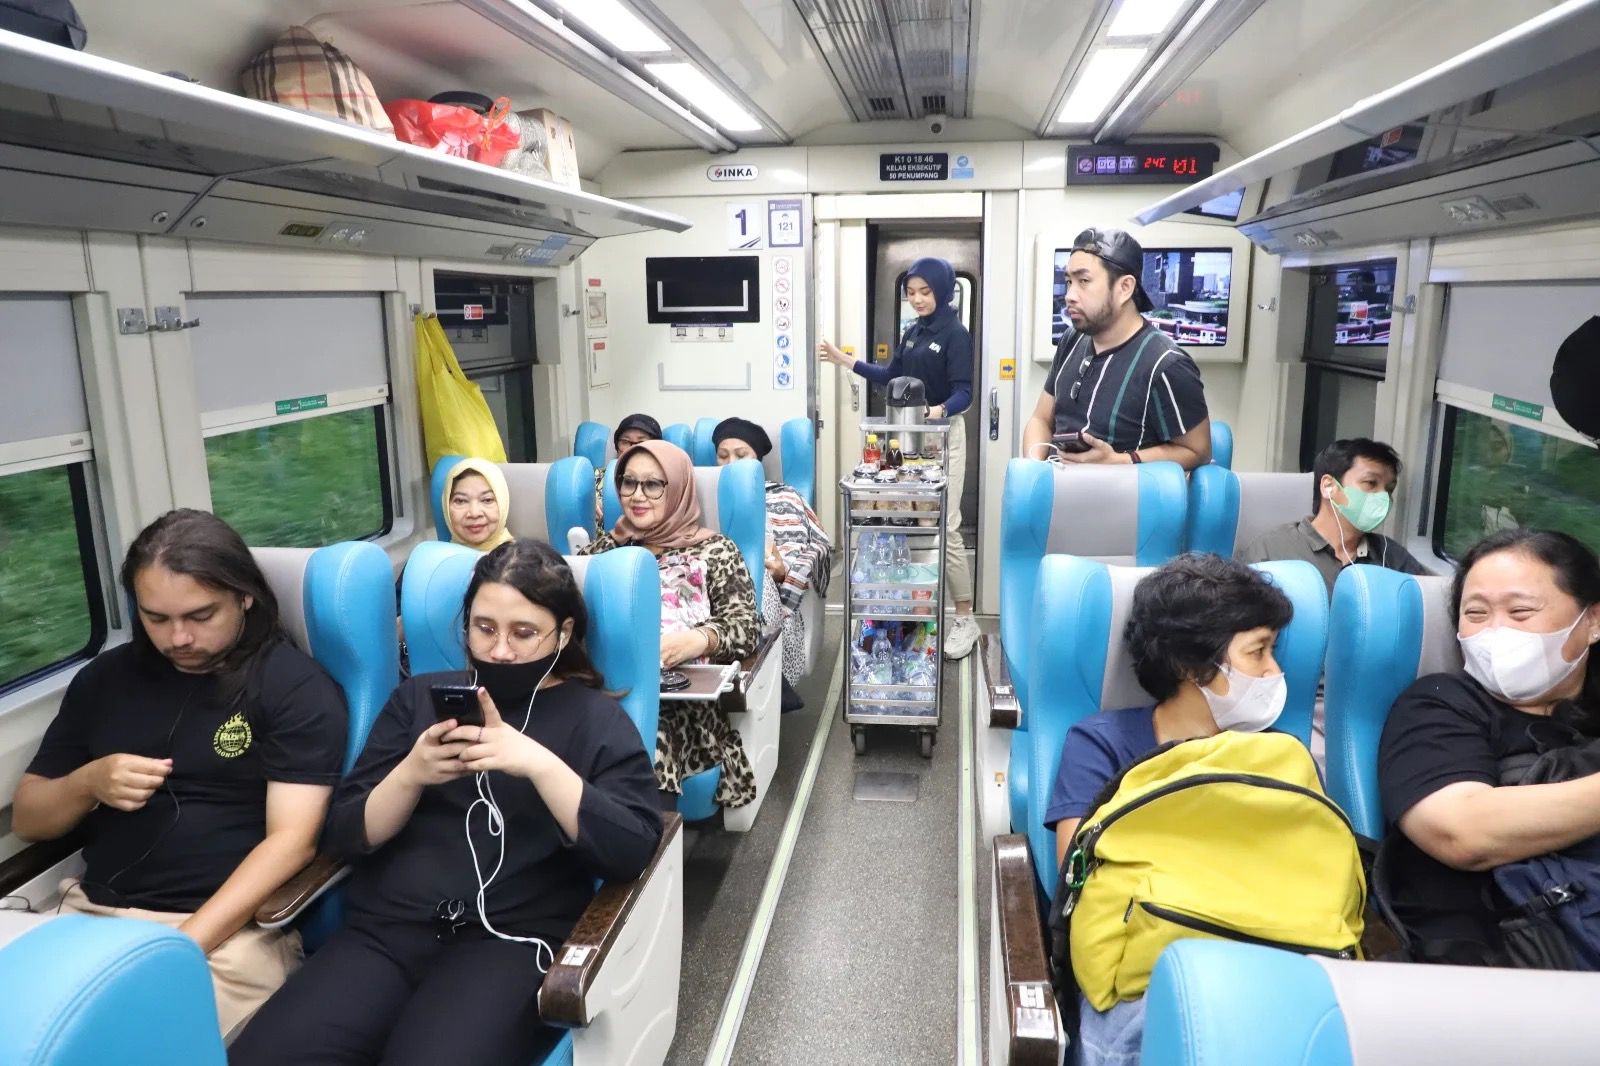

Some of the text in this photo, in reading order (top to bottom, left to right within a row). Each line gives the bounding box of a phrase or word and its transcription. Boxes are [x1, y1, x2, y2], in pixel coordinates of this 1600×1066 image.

[723, 168, 753, 177] INKA
[735, 209, 747, 236] 1
[778, 222, 793, 232] 121
[214, 746, 244, 757] WITHOUT
